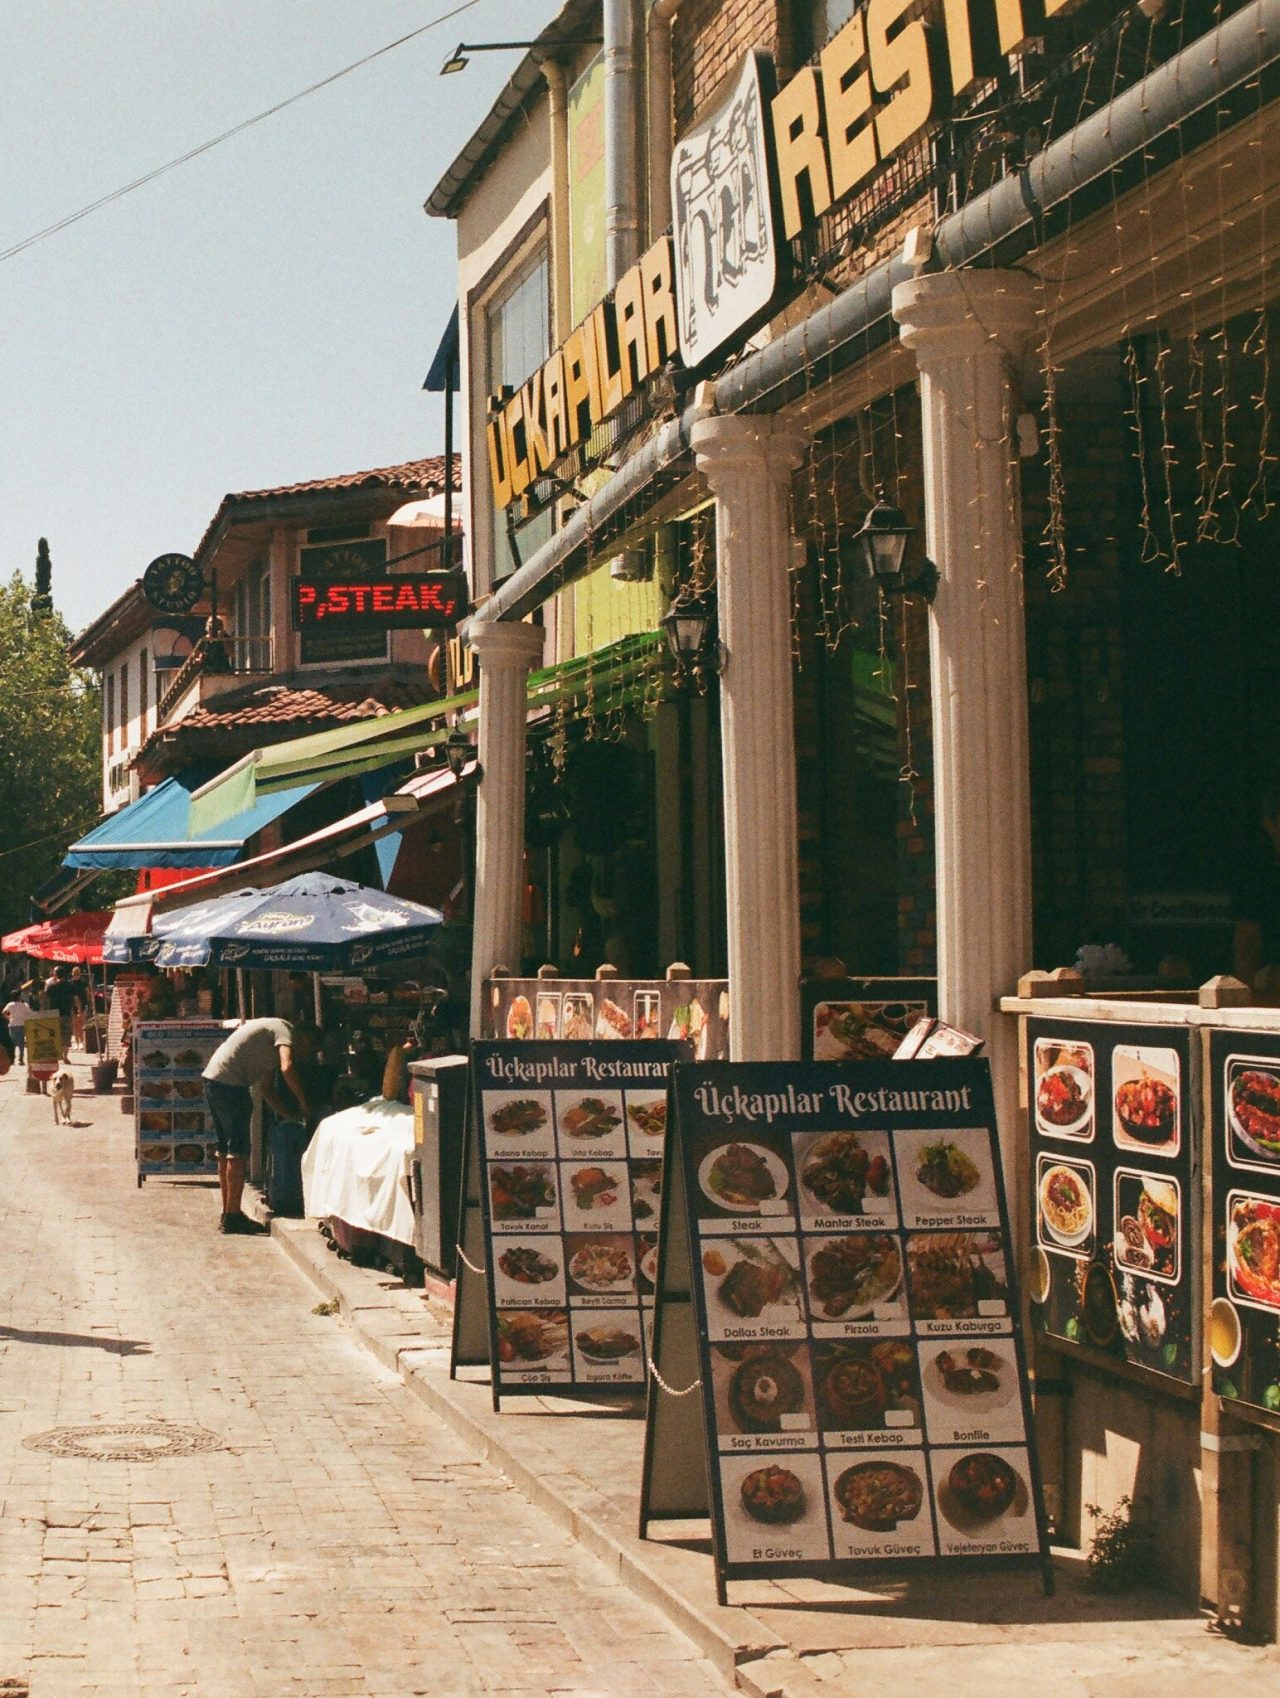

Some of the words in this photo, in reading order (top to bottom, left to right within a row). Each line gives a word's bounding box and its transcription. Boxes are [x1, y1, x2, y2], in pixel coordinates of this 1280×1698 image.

[487, 236, 677, 517] ÜÇKAPILAR
[485, 1053, 578, 1083] Üçkapılar
[694, 1081, 824, 1123] Üçkapılar
[829, 1084, 972, 1118] Restaurant
[732, 1220, 762, 1230] Steak
[814, 1217, 853, 1228] Mantar
[856, 1217, 885, 1227] Steak
[915, 1215, 955, 1226] Pepper
[957, 1214, 987, 1225] Steak
[723, 1326, 757, 1338] Dallas
[759, 1325, 790, 1337] Steak
[844, 1323, 879, 1335] Pirzola
[926, 1321, 953, 1332] Kuzu
[955, 1320, 1001, 1332] Kaburga
[840, 1434, 865, 1444] Testi
[867, 1433, 904, 1445] Kebap
[953, 1430, 990, 1441] Bonfile
[731, 1436, 751, 1450] Saç
[755, 1435, 805, 1447] Kavurma
[753, 1548, 764, 1559] Et
[766, 1547, 803, 1560] Güveç
[848, 1545, 882, 1556] Tavuk
[884, 1543, 921, 1556] Güveç
